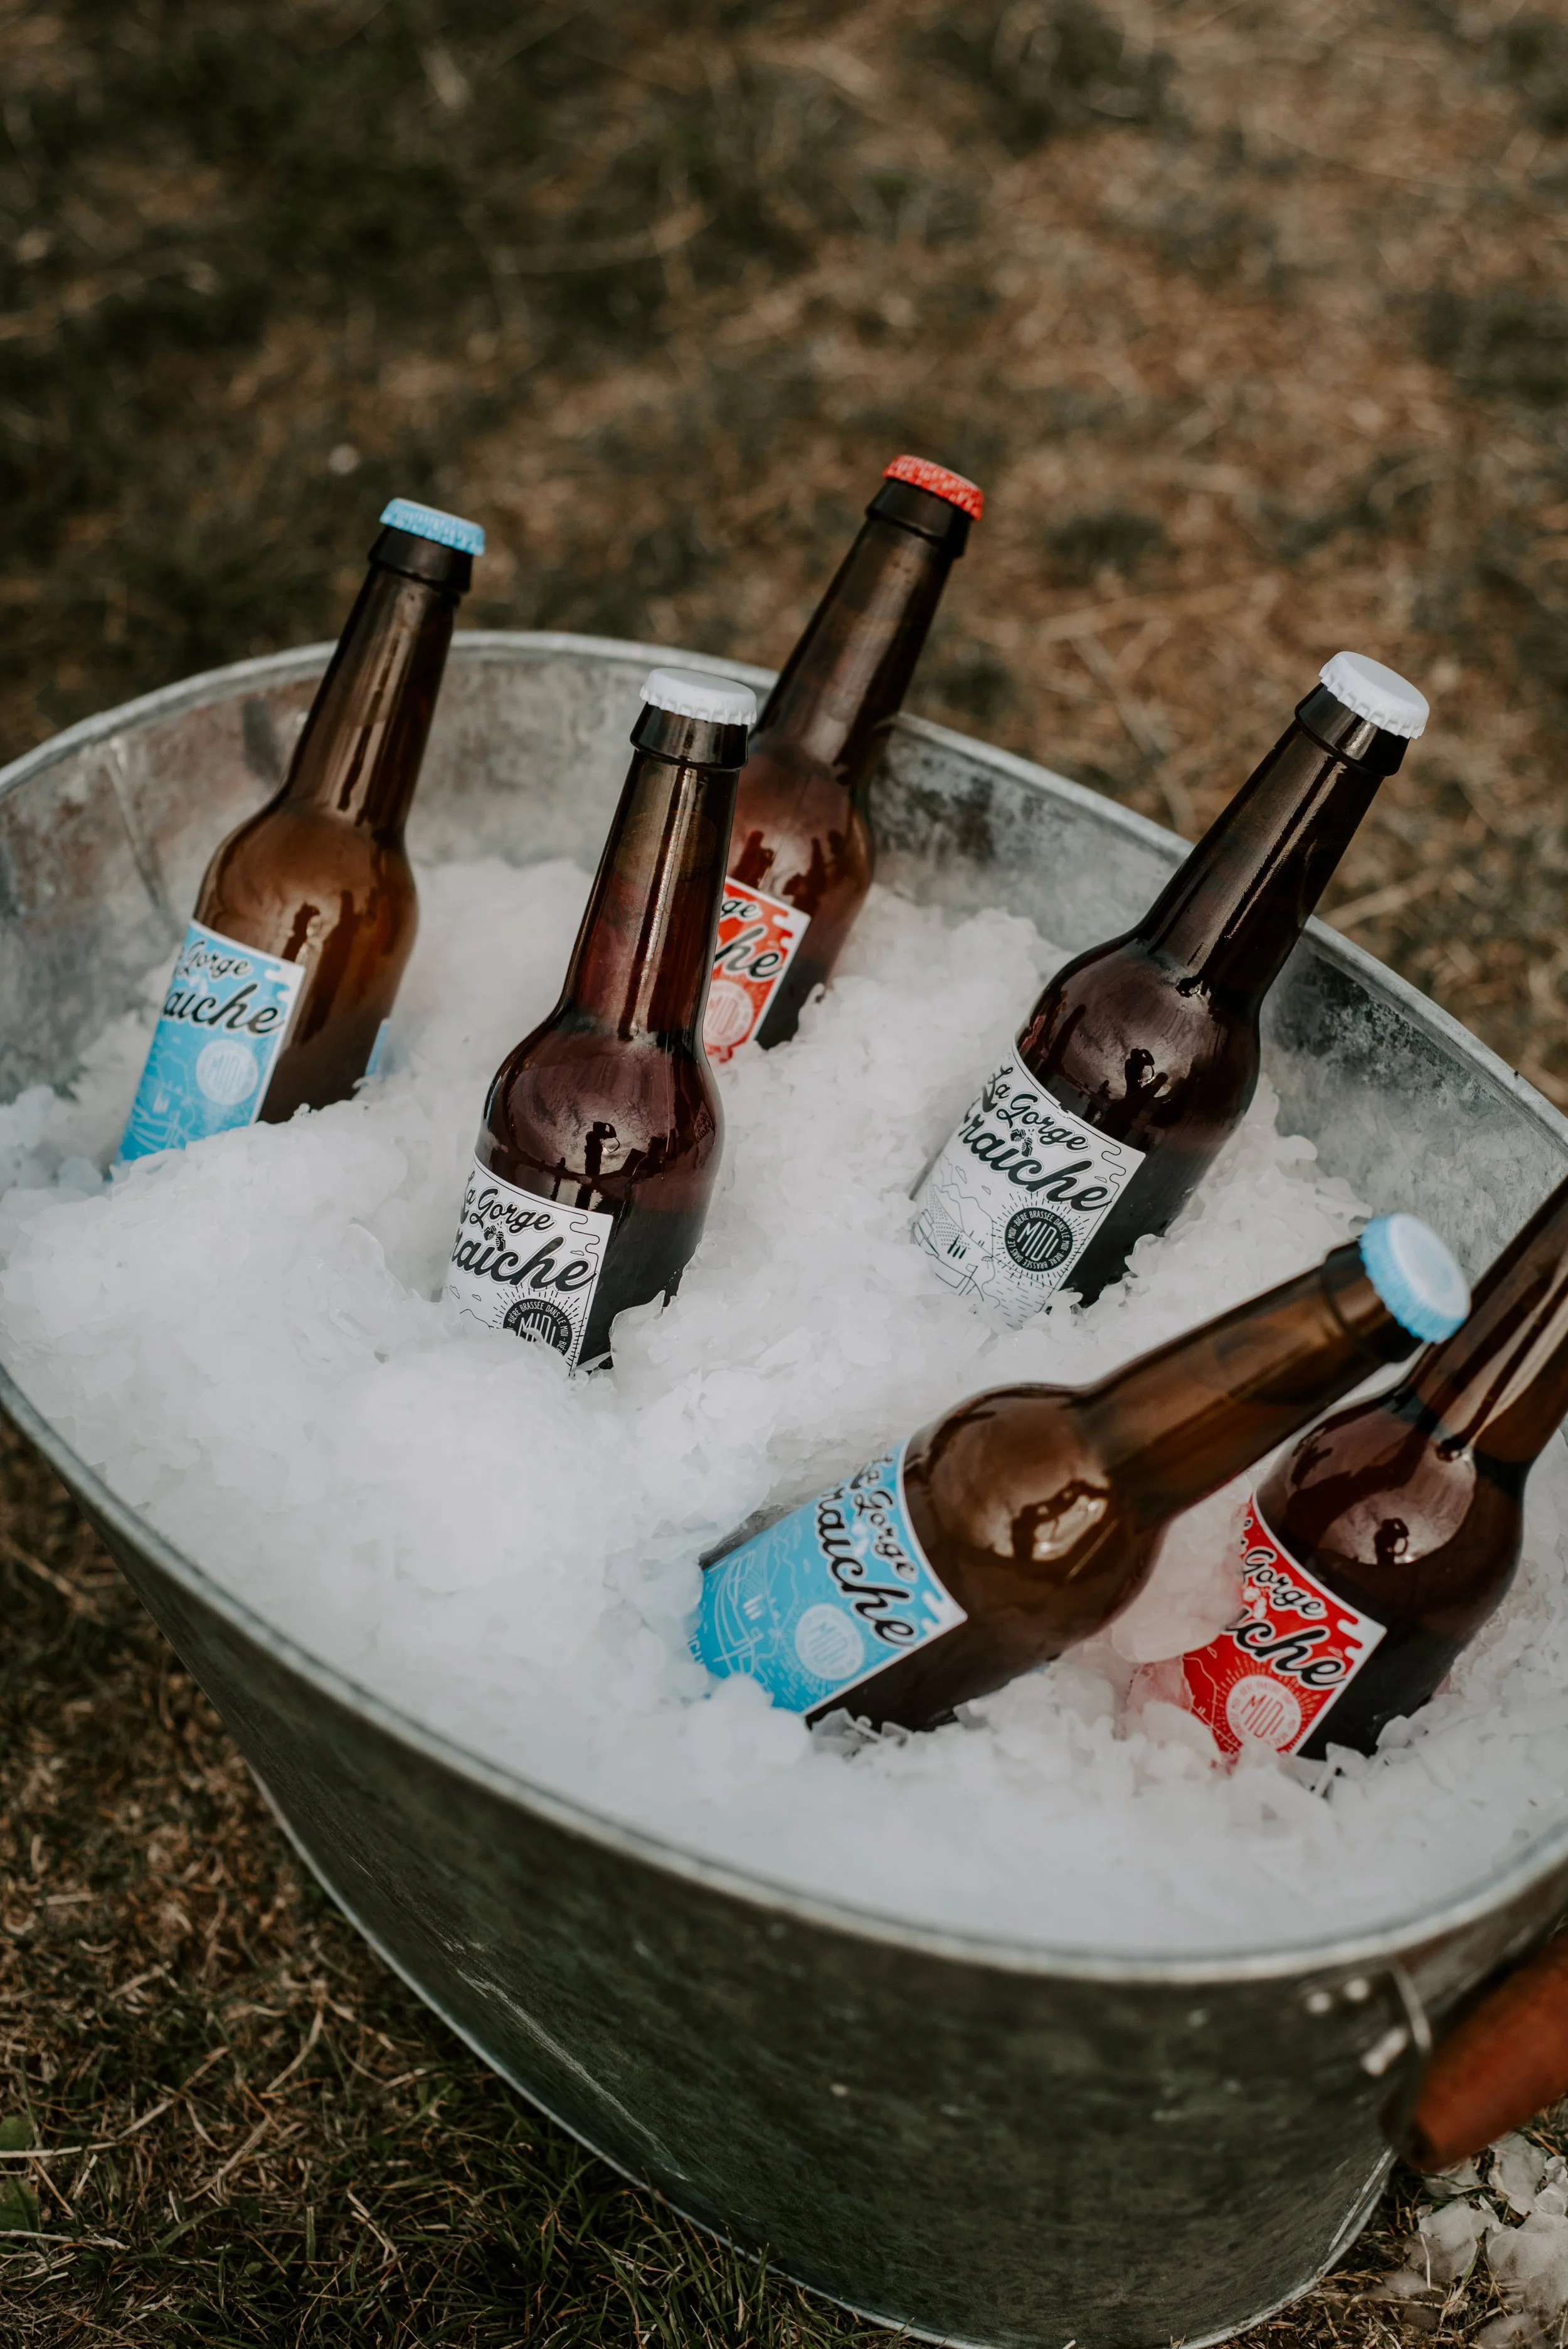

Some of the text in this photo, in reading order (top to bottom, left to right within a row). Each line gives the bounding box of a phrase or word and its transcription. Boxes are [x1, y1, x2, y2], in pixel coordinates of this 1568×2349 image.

[177, 940, 250, 979] Gorge
[164, 983, 285, 1034] aiche
[996, 1093, 1088, 1150] Gorge
[470, 1188, 553, 1233] Gorge
[1007, 1227, 1017, 1239] MIDI
[1014, 1212, 1029, 1227] BIÈRE
[1029, 1211, 1054, 1222] BRASSÉE
[1054, 1218, 1067, 1232] DANS
[1061, 1240, 1070, 1251] MIDI
[1017, 1221, 1059, 1261] MIDI
[452, 1228, 596, 1291] raiche
[1010, 1248, 1024, 1263] DANS
[508, 1307, 521, 1323] BIÈRE
[519, 1300, 544, 1312] BRASSÉE
[545, 1305, 560, 1318] DANS
[556, 1316, 566, 1325] LE
[517, 1313, 556, 1346] MIDI
[560, 1325, 568, 1337] MIDI
[855, 1490, 915, 1576] Gorge
[818, 1487, 916, 1646] raiche
[1243, 1549, 1323, 1615] Gorge
[1240, 1694, 1285, 1738] MIDI
